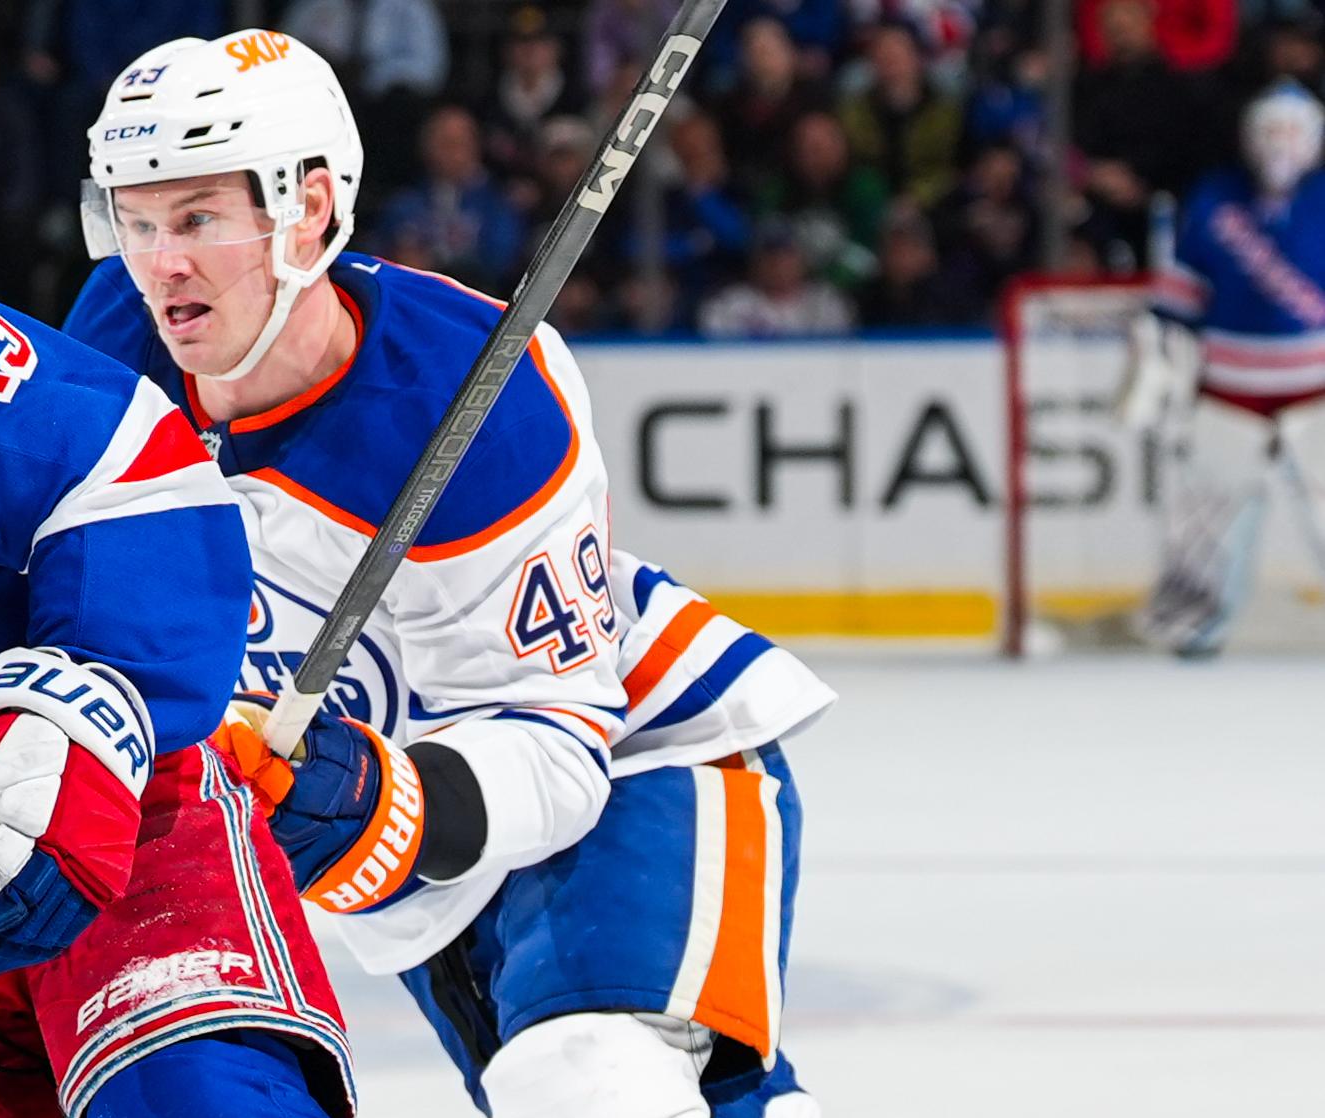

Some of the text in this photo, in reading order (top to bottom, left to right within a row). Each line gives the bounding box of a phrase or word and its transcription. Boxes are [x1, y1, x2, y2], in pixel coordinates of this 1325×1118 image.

[225, 31, 290, 73] SKIP
[578, 34, 702, 213] CCM
[104, 124, 157, 142] CCM
[420, 335, 536, 481] RIBCOR
[506, 523, 619, 674] 49
